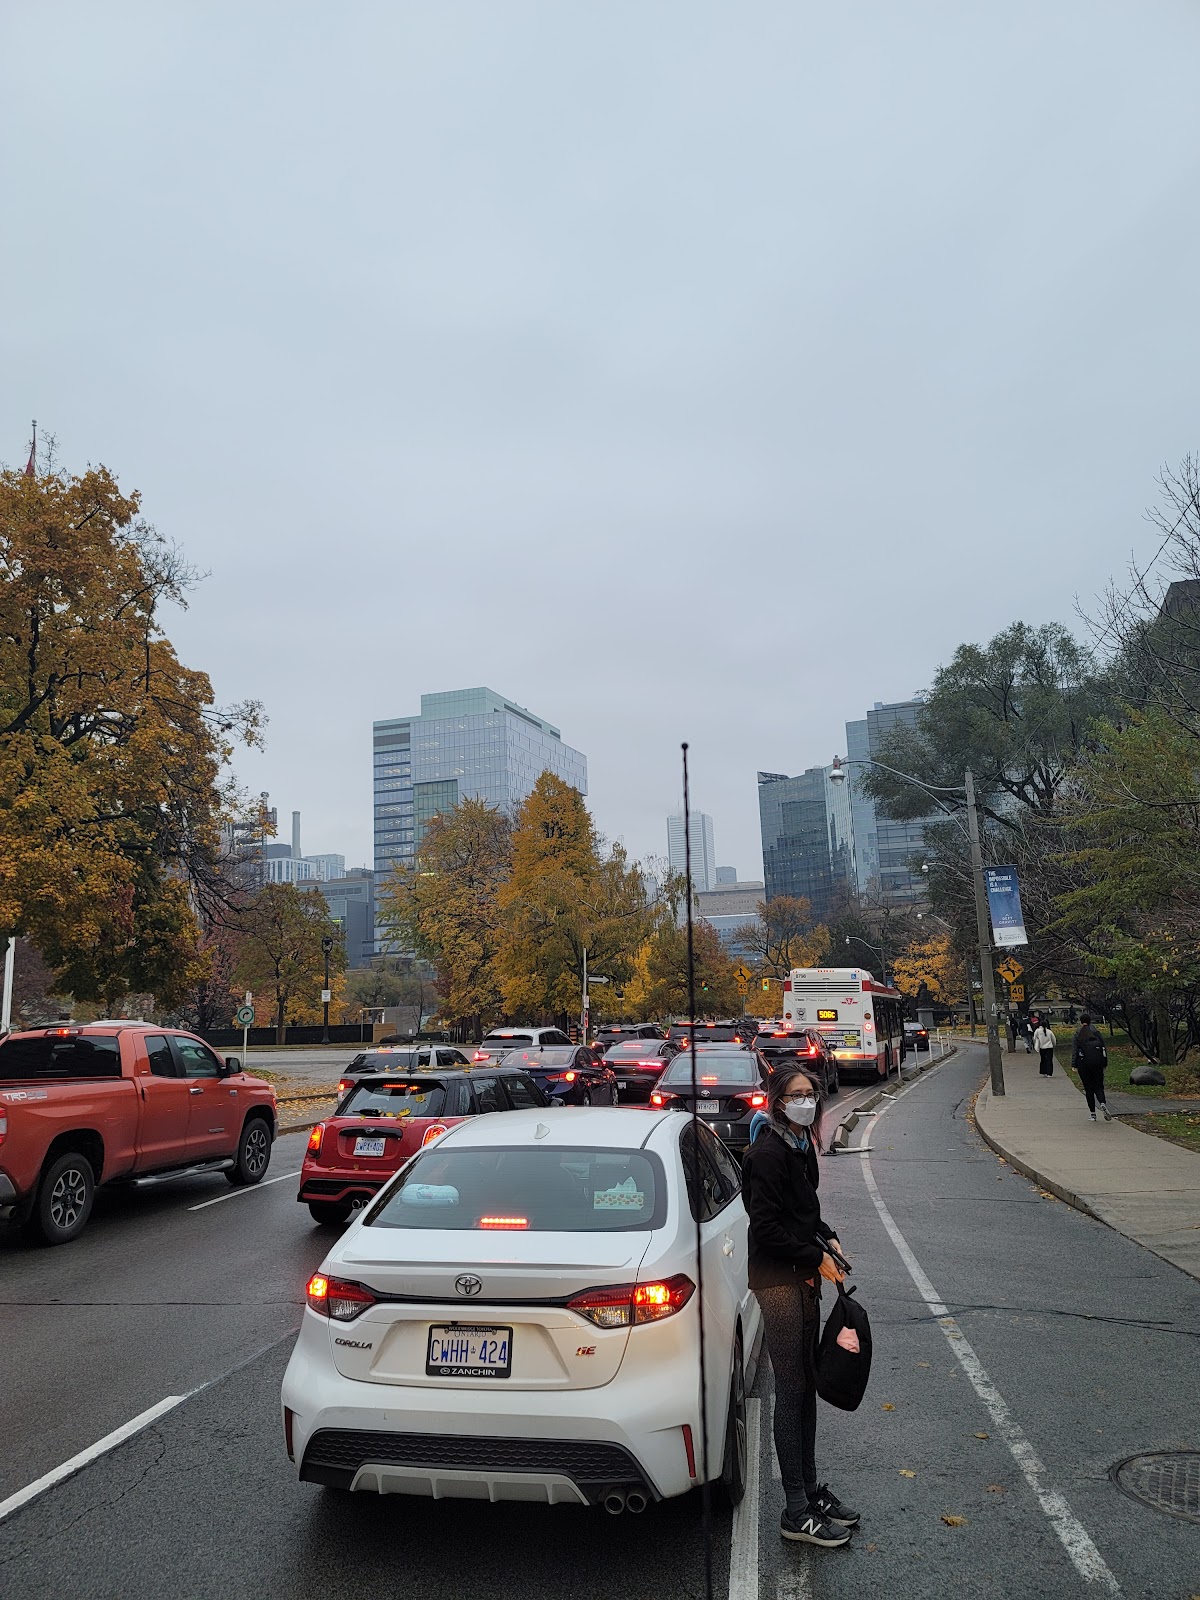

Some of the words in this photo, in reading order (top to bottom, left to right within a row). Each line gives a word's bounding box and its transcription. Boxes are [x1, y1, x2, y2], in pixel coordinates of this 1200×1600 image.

[1012, 986, 1023, 995] 40
[819, 1011, 836, 1019] 506C
[454, 1330, 487, 1338] ONTARIO
[335, 1337, 373, 1350] COROLLA
[431, 1339, 469, 1363] CWHH
[479, 1340, 507, 1363] 424
[452, 1368, 496, 1376] ZANCHIN
[801, 1518, 822, 1535] N
